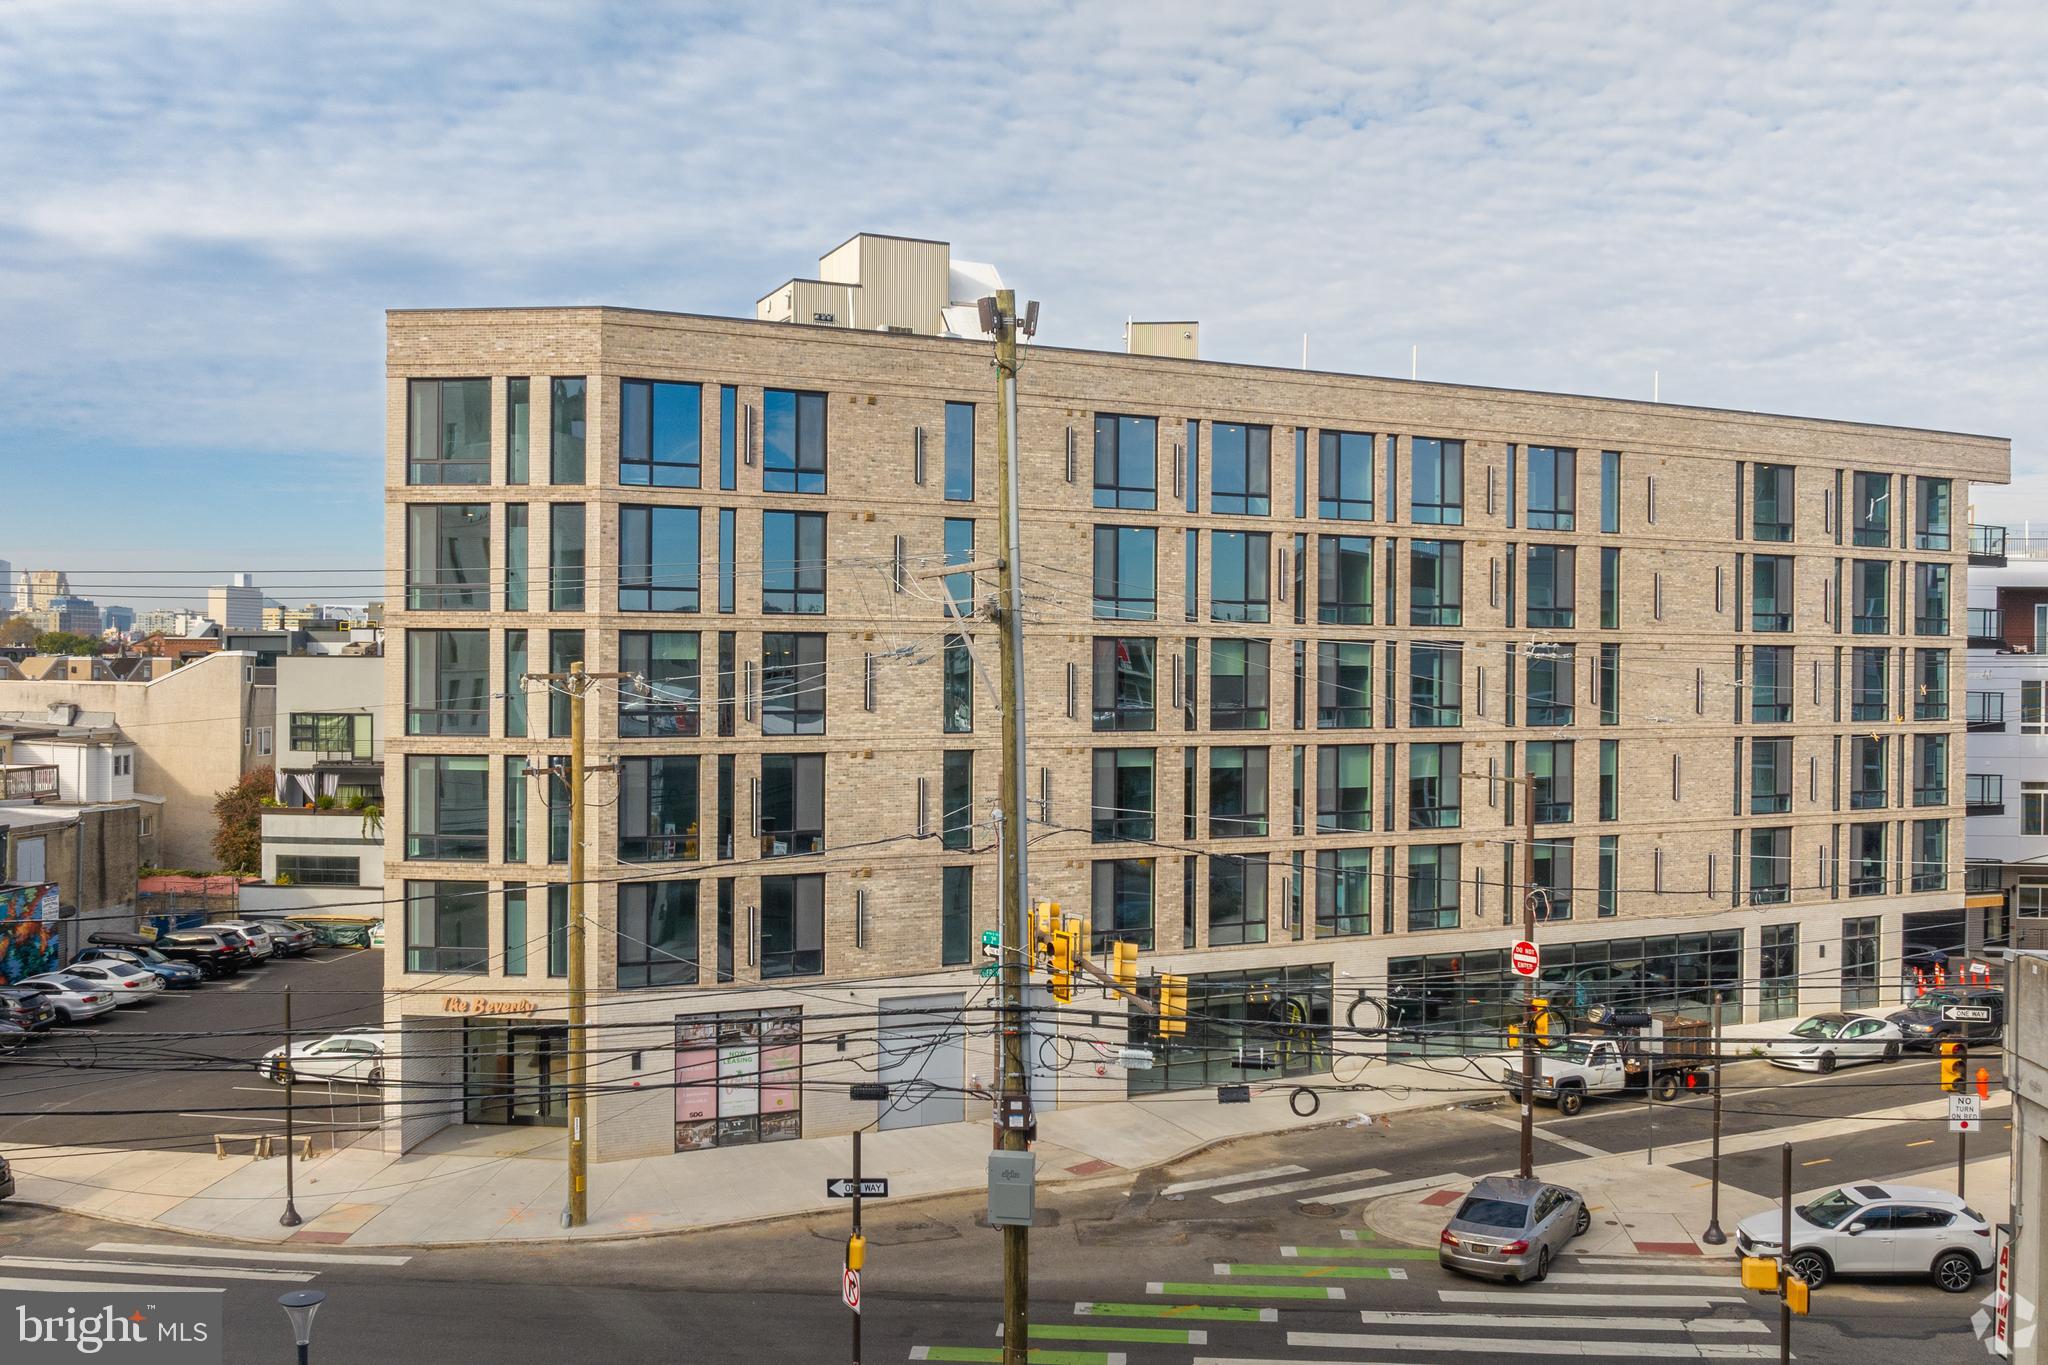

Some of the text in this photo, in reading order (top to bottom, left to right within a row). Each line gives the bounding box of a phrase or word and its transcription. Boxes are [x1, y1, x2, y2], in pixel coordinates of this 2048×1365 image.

[442, 994, 536, 1017] The Beverly
[723, 1057, 753, 1065] LEASING
[1957, 1097, 1972, 1105] NO
[864, 1183, 881, 1192] WAY
[1997, 1245, 2009, 1341] ACME
